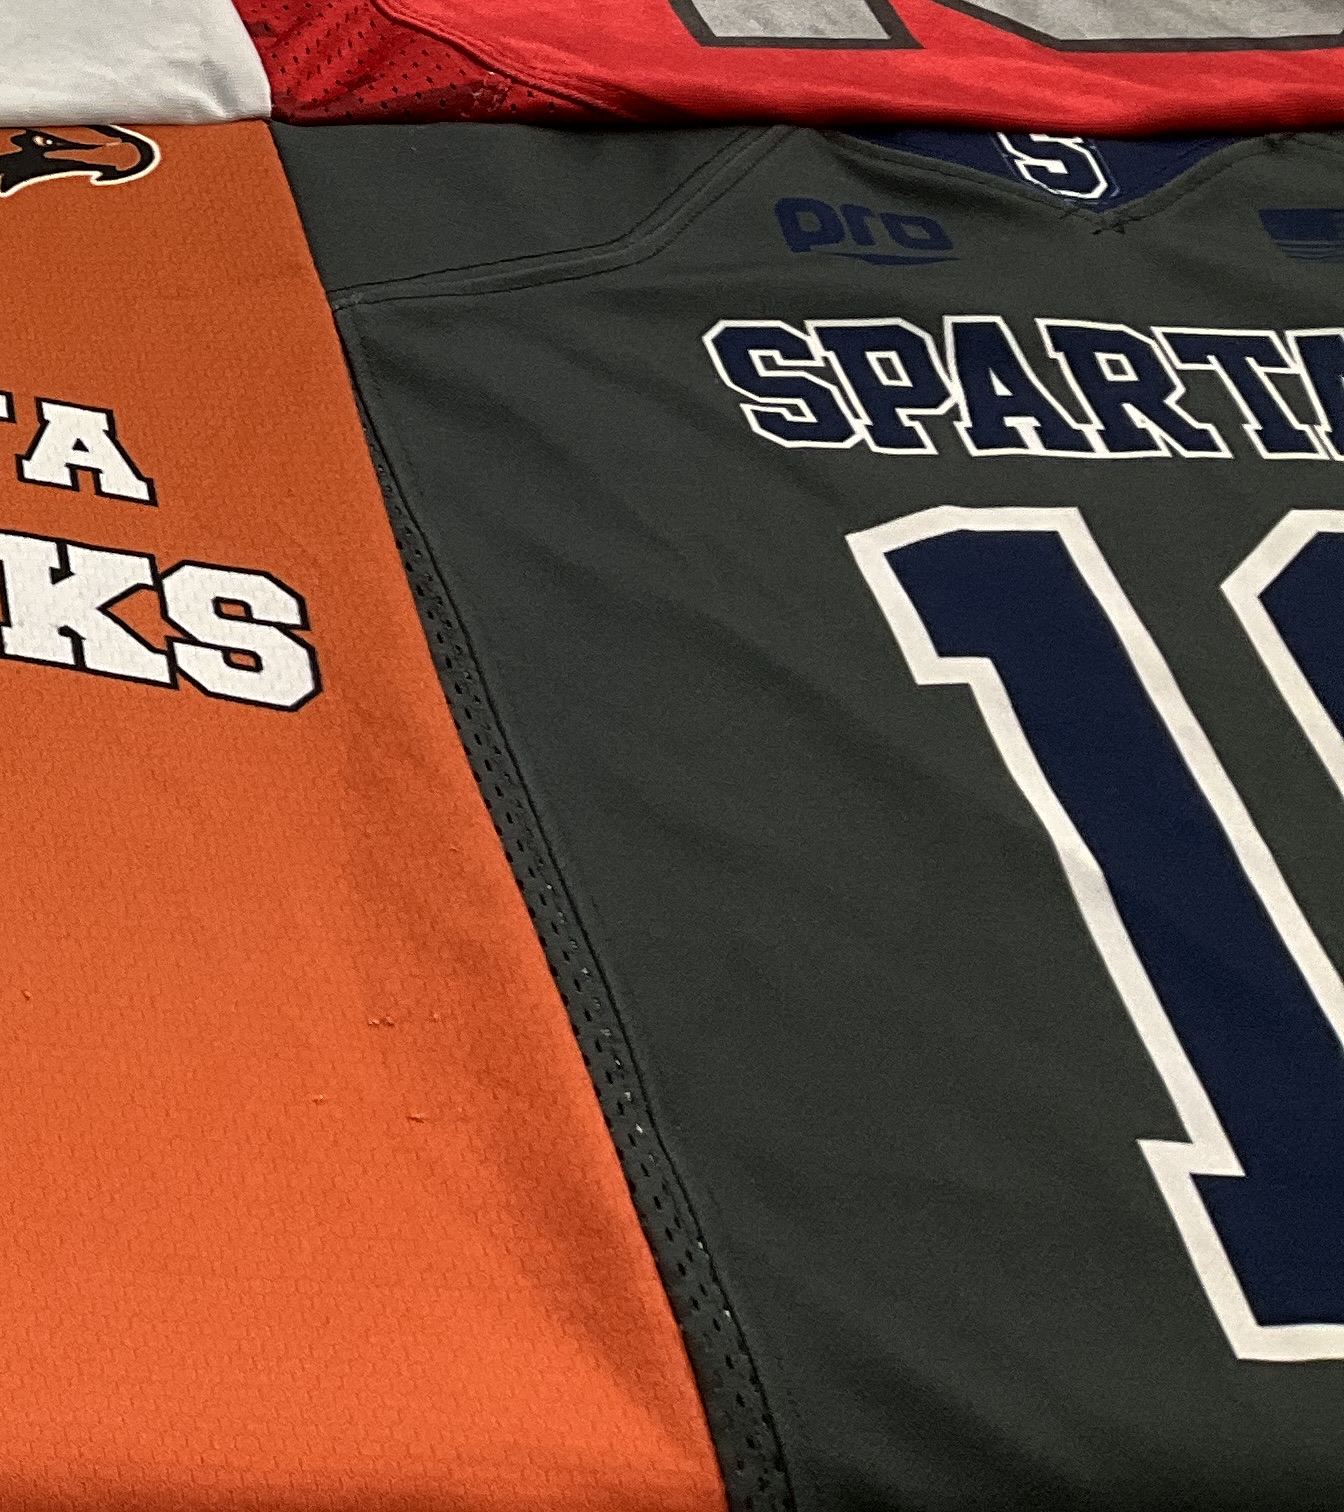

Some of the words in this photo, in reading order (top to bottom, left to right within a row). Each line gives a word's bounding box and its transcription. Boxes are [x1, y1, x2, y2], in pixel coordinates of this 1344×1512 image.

[774, 196, 955, 254] pro
[702, 316, 1344, 462] SPART
[844, 505, 1344, 1362] 1
